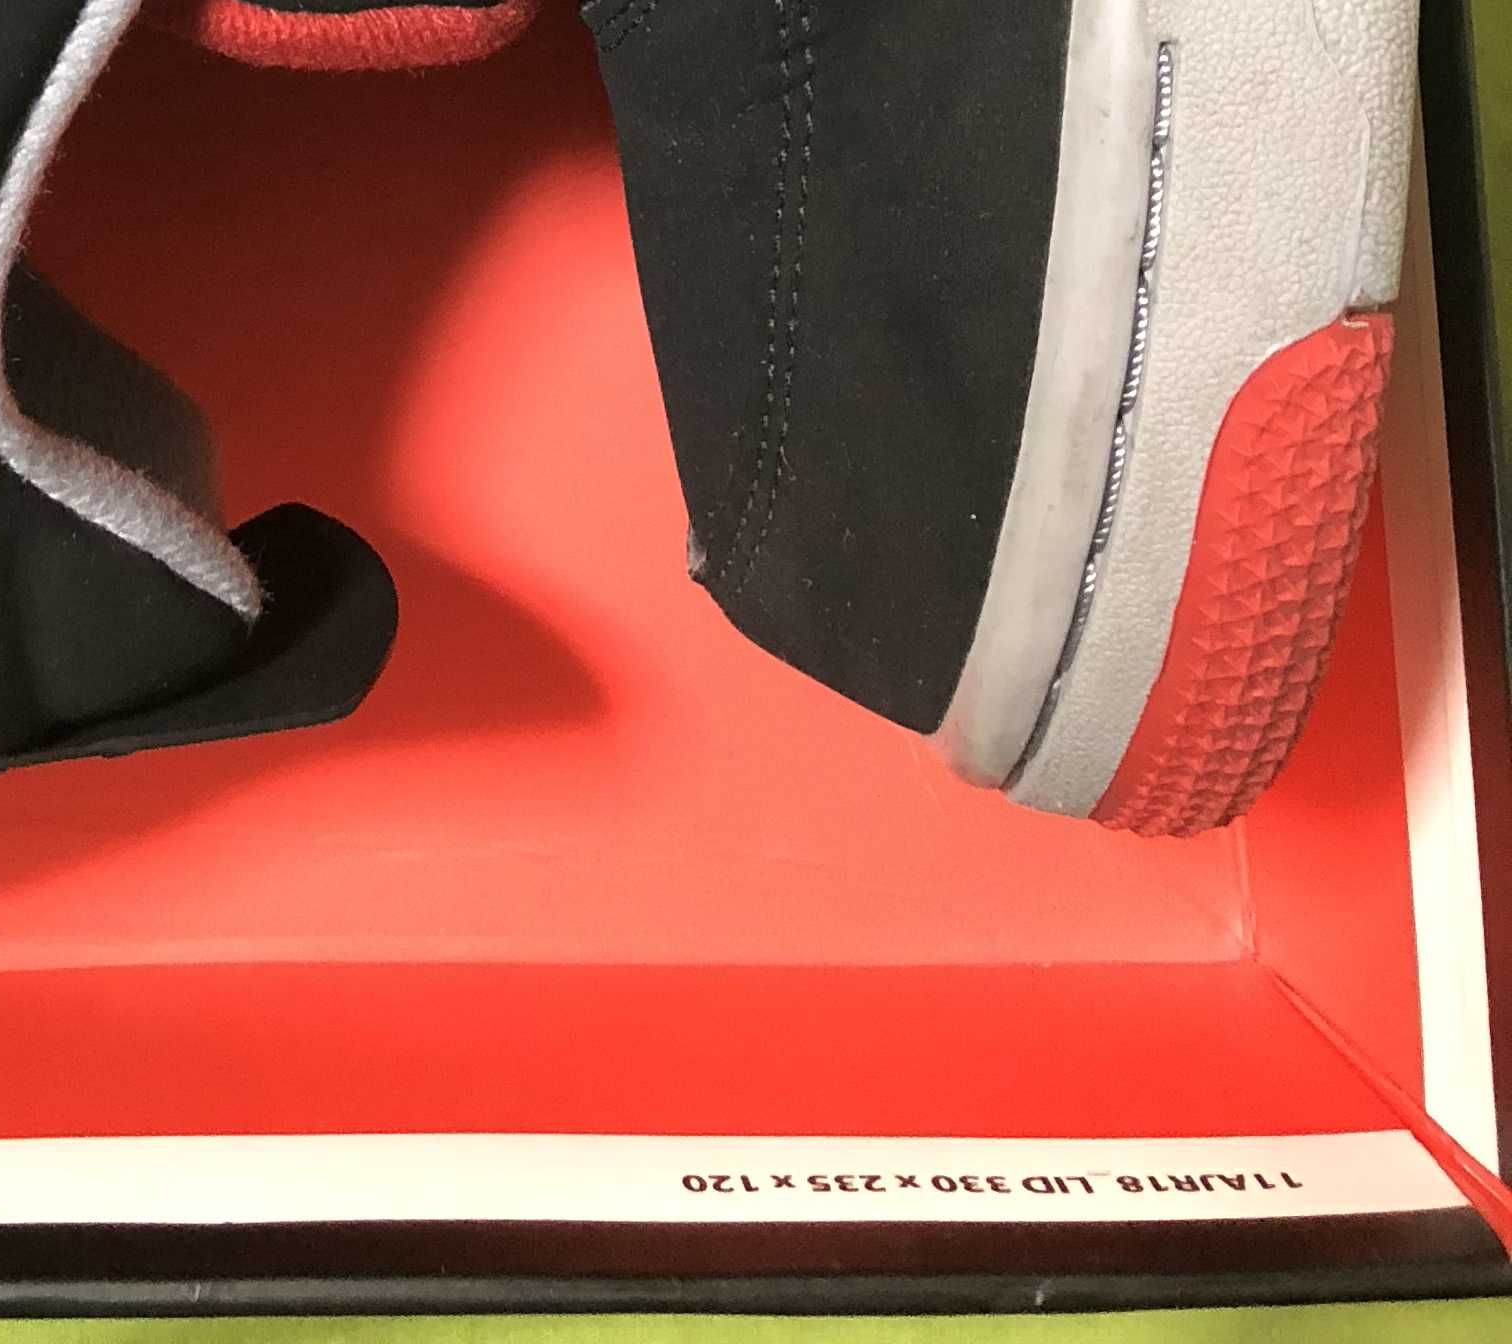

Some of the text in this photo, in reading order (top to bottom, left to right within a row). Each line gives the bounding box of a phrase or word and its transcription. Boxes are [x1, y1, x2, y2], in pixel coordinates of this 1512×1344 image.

[681, 1174, 759, 1193] 120
[770, 1175, 796, 1189] x
[807, 1175, 886, 1193] 235
[894, 1175, 921, 1188] x
[931, 1175, 1011, 1194] 330
